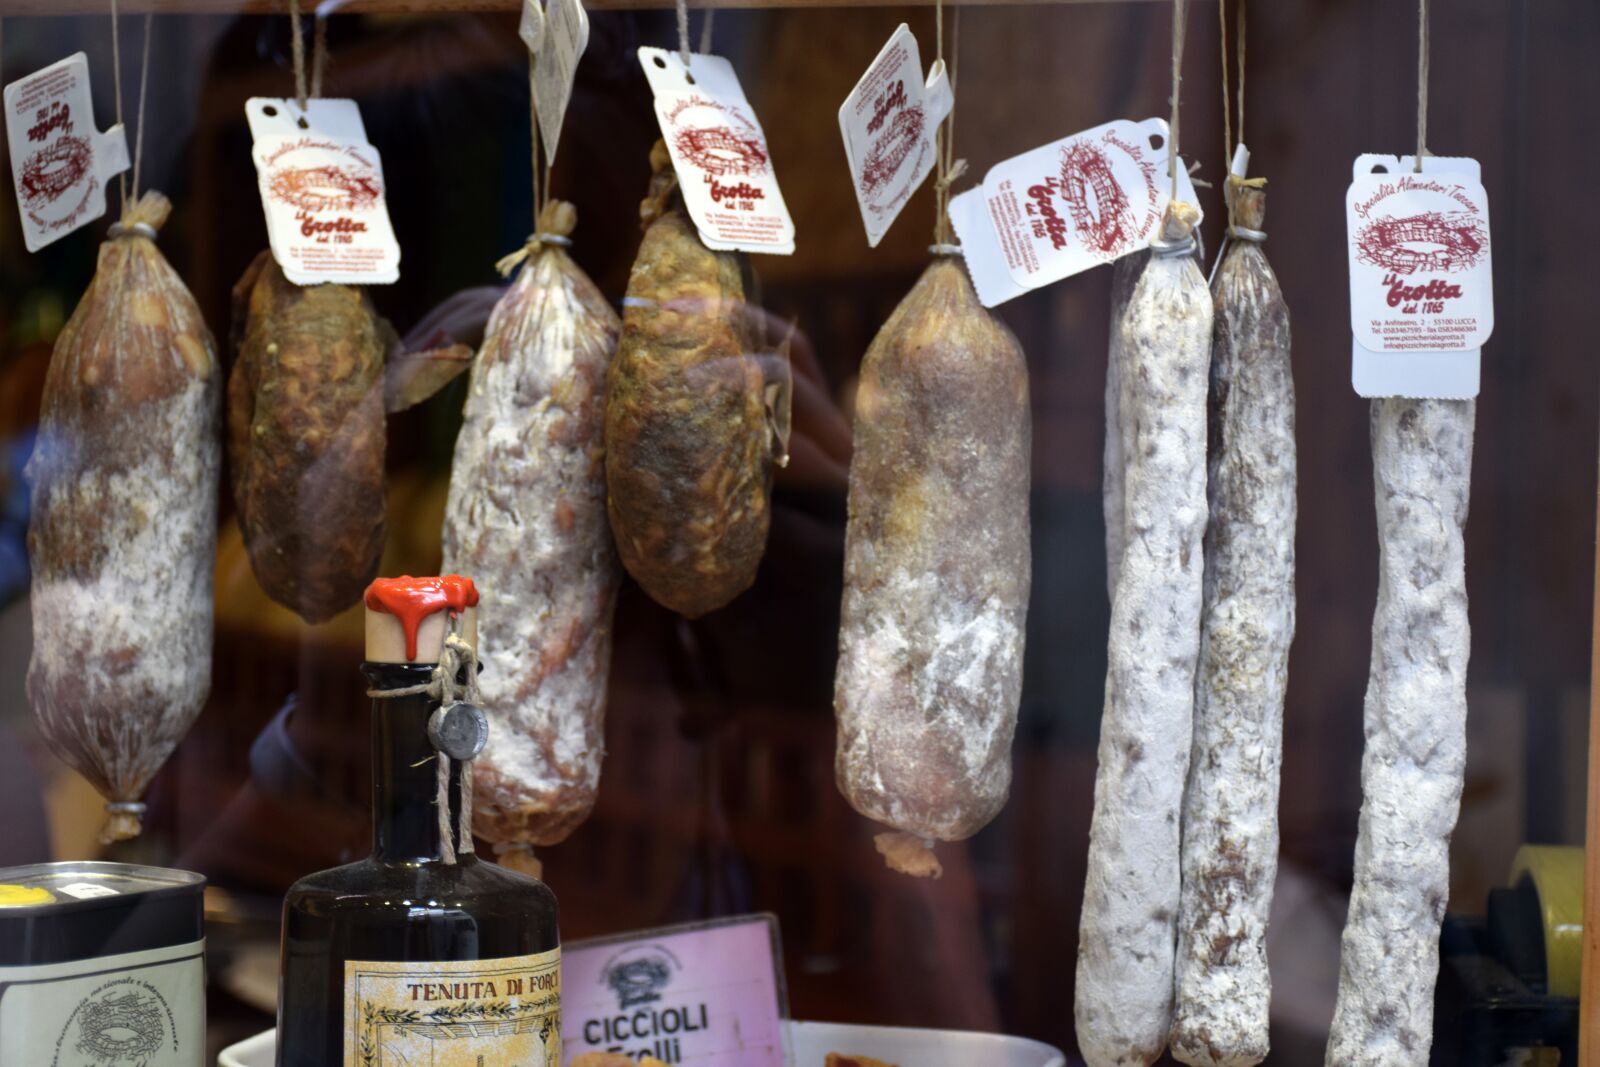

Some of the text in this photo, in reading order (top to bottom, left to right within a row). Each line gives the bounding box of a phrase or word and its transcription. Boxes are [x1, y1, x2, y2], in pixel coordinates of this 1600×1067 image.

[26, 103, 70, 142] Grotta
[710, 180, 765, 203] Grotta
[1354, 183, 1395, 219] Specialità
[1397, 176, 1451, 194] Alimentari
[301, 217, 368, 237] Grotta
[1027, 184, 1068, 250] Grotta
[1382, 273, 1464, 307] LA Grotta
[1421, 301, 1445, 314] 1865
[91, 976, 135, 996] nazionale
[407, 981, 497, 1001] TENUTA
[506, 978, 523, 996] DI
[584, 1003, 708, 1046] CICCIOLI
[606, 1037, 682, 1065] olli
